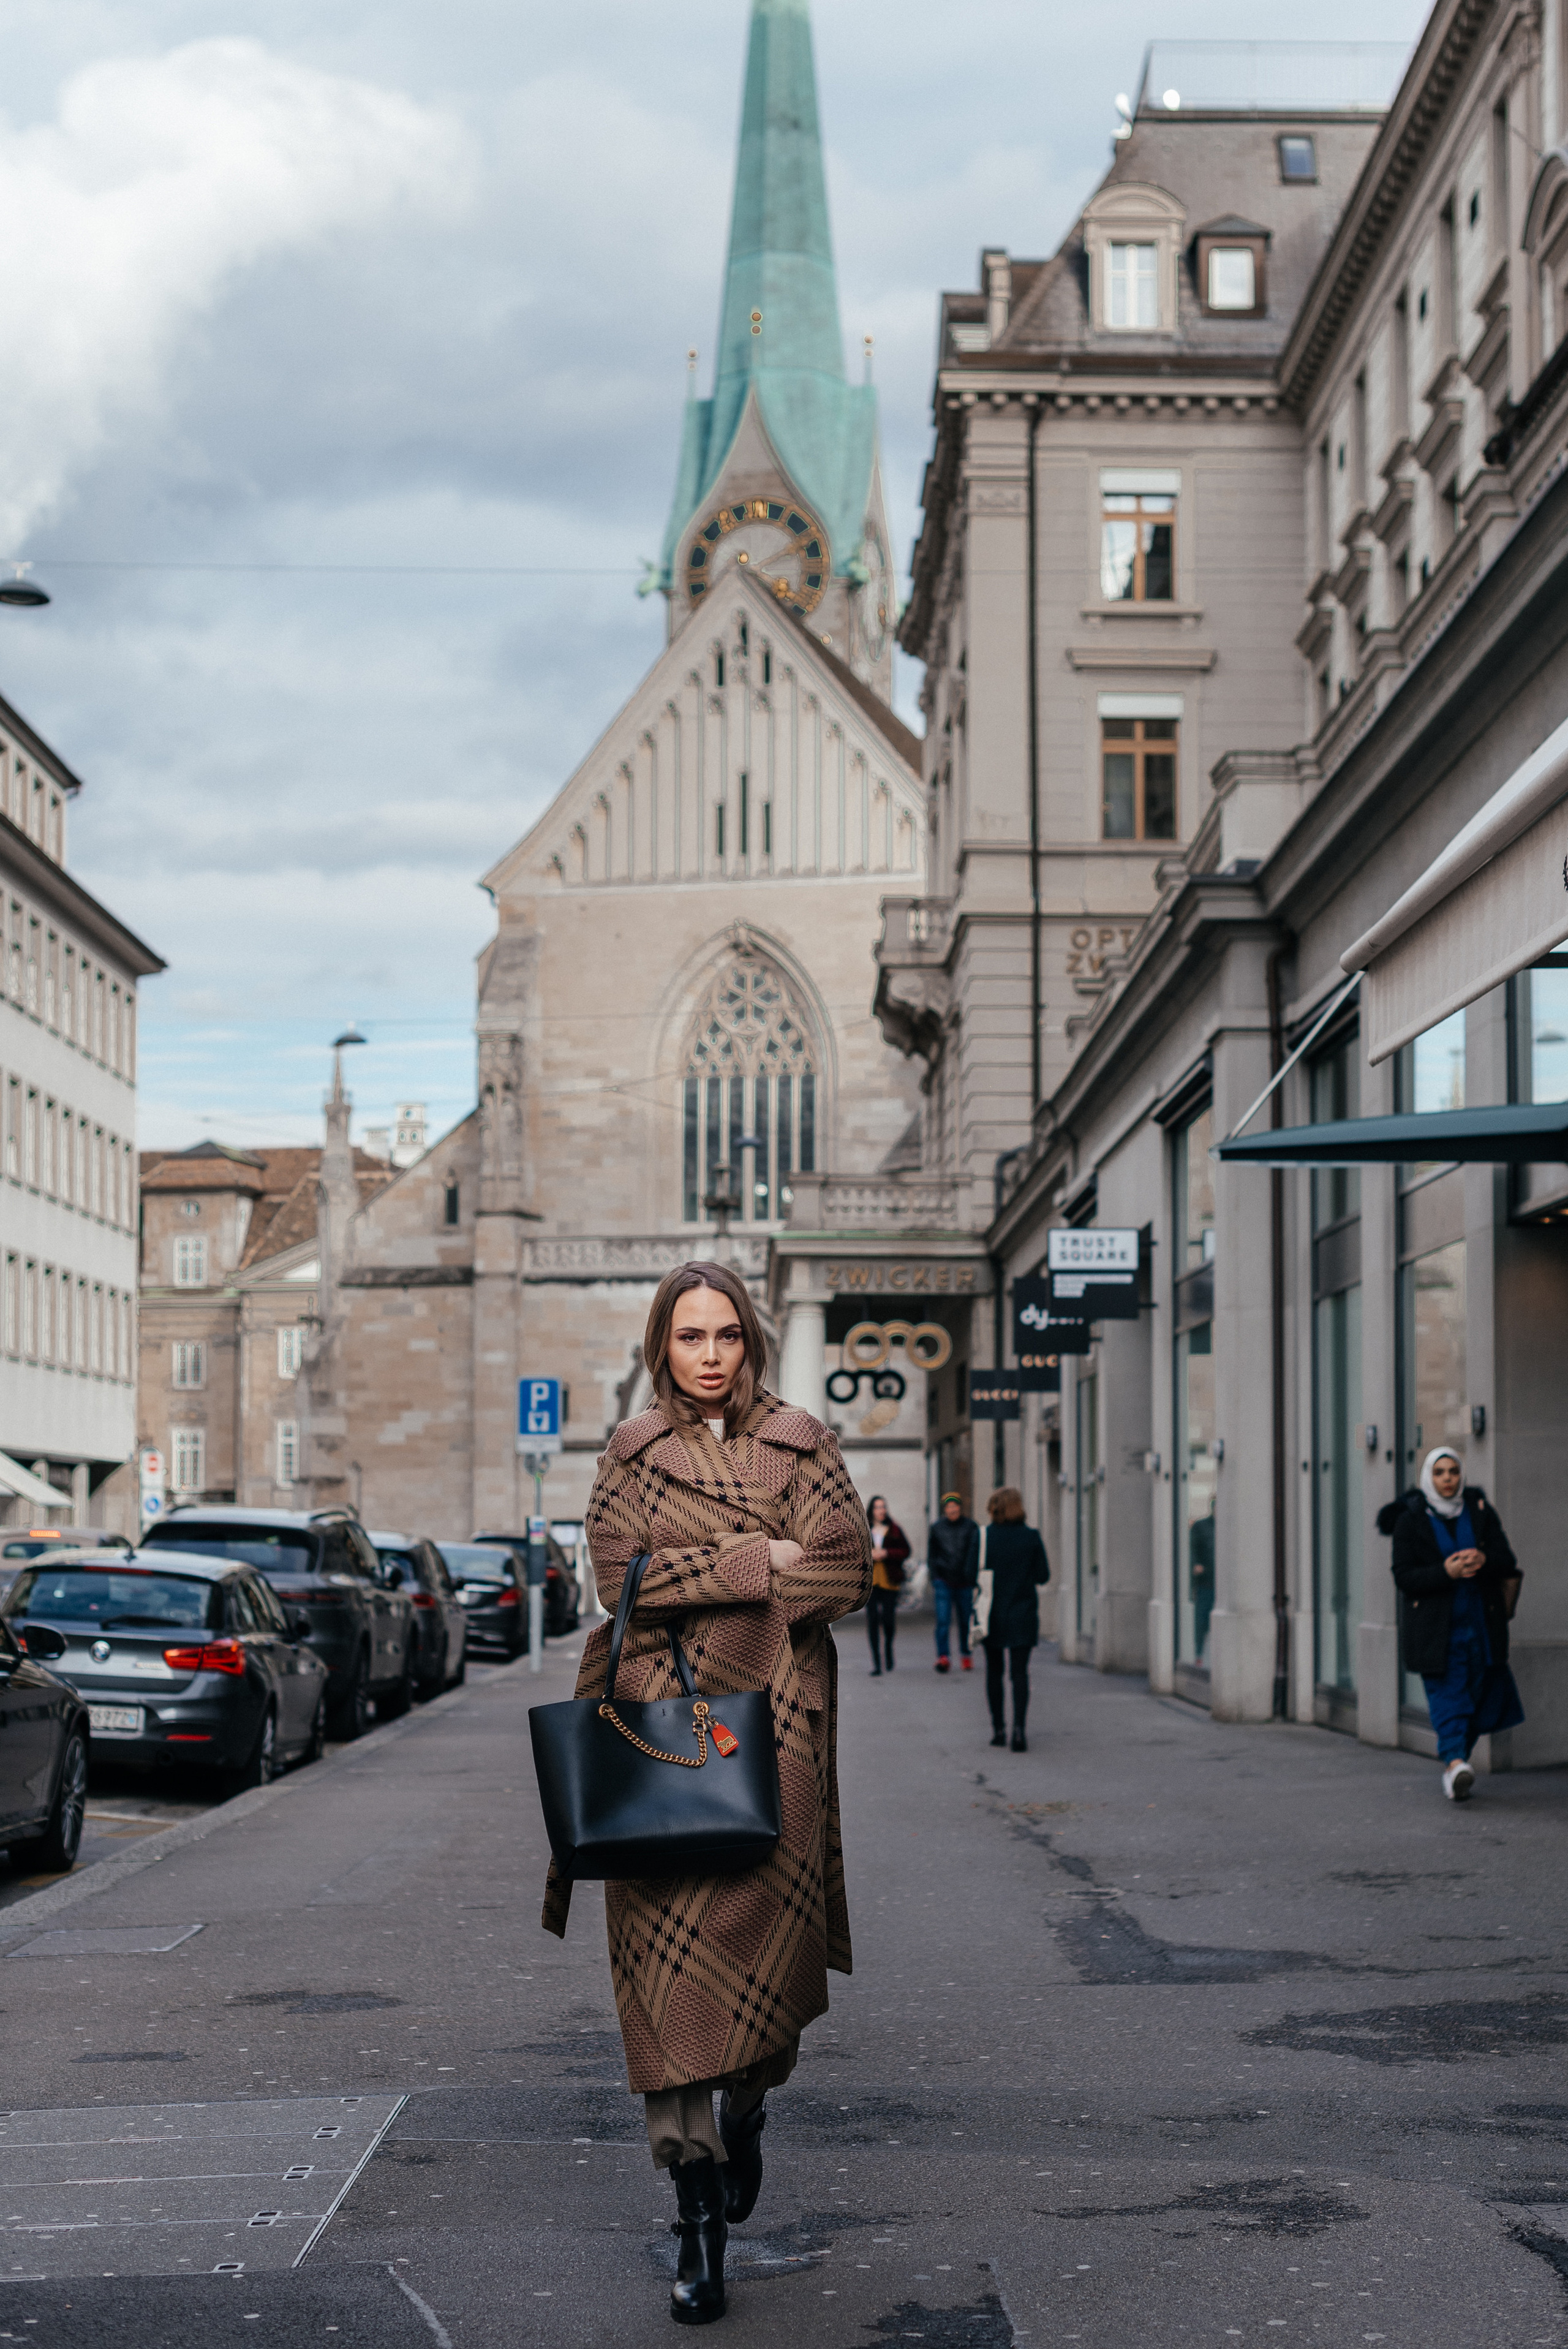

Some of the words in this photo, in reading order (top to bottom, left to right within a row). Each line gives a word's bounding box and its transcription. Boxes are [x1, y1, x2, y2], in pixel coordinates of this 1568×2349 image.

[1060, 1238, 1115, 1247] TRUST
[1060, 1250, 1128, 1261] SQUARE
[826, 1265, 976, 1289] ZWICKER
[530, 1382, 549, 1411] P
